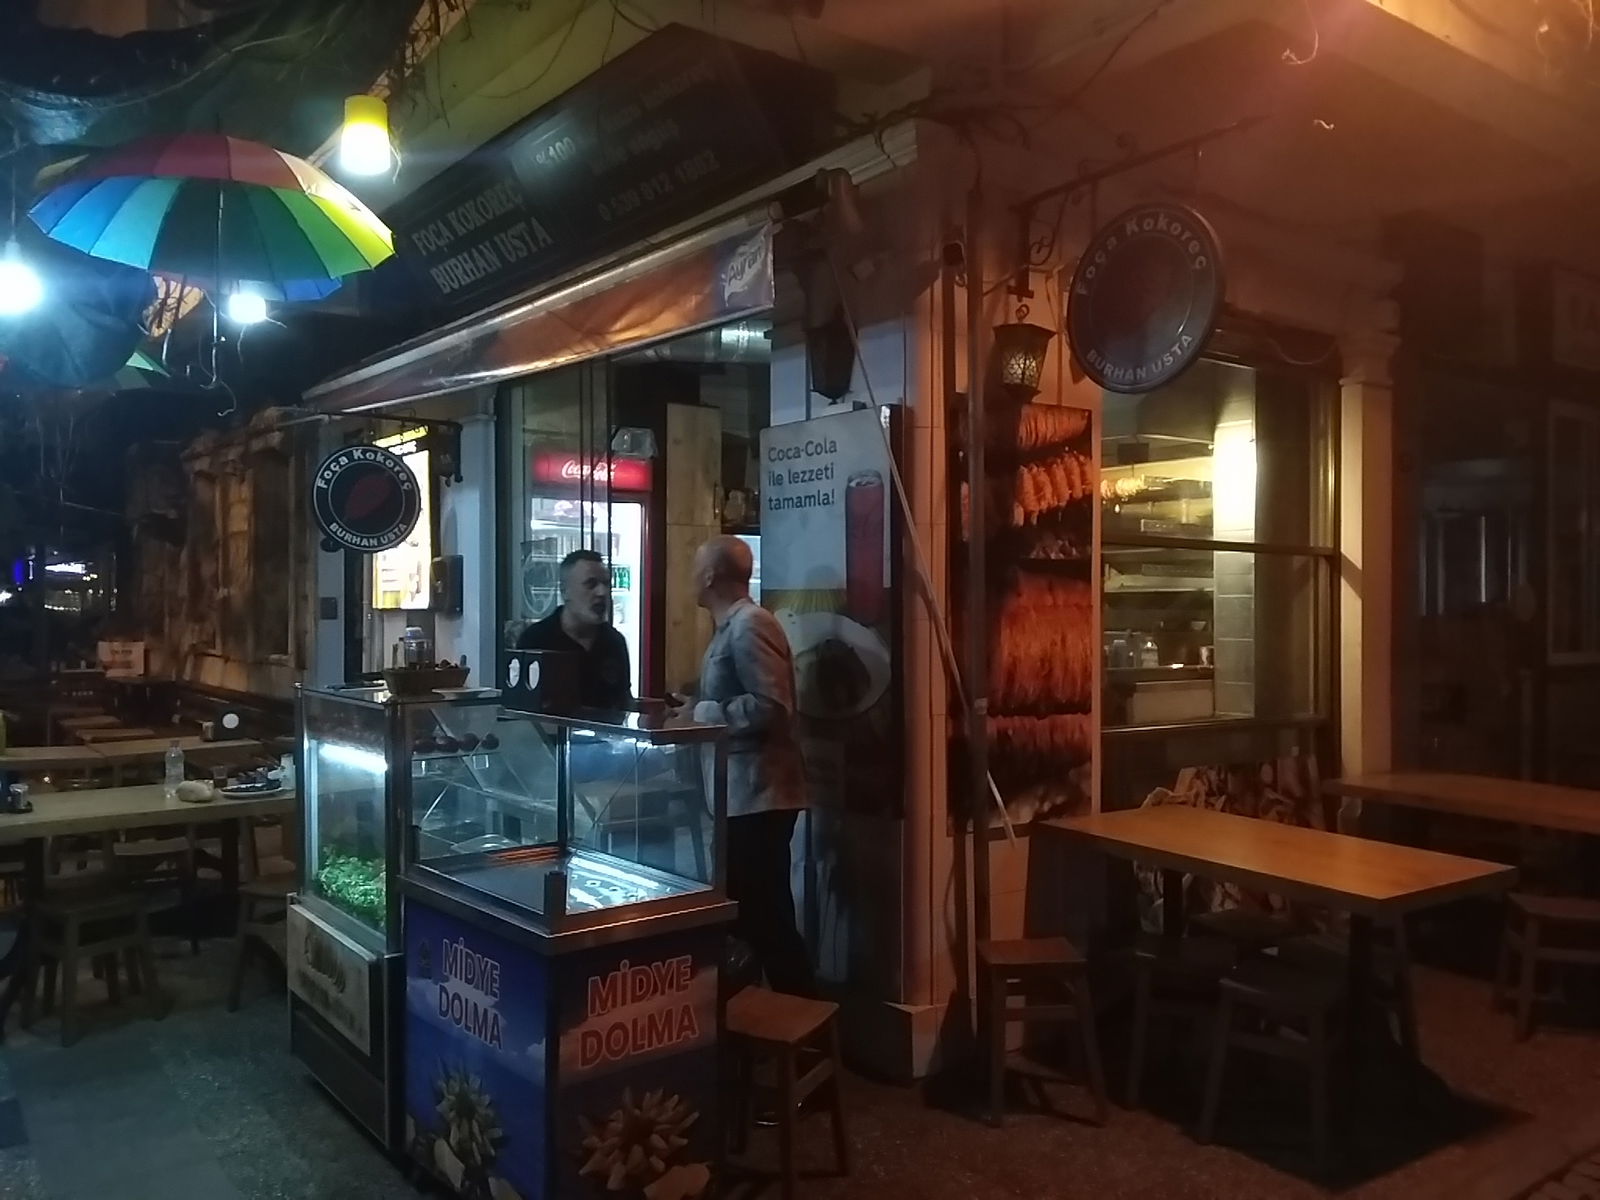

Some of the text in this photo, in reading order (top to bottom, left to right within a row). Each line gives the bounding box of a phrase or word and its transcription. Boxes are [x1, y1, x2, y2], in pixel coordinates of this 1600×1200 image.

[411, 178, 526, 256] FOÇA KOKOREÇ
[429, 216, 553, 294] BURHAN USTA
[1086, 334, 1193, 380] BURHAN USTA
[317, 449, 412, 490] Foça Kokoreç
[768, 462, 834, 487] ile lezzeti
[768, 489, 835, 511] tamamla!
[329, 522, 407, 547] BURHAN USTA
[443, 937, 500, 999] MİDYE
[587, 955, 693, 1017] MİDYE
[439, 984, 503, 1049] DOLMA
[580, 1004, 700, 1068] DOLMA
